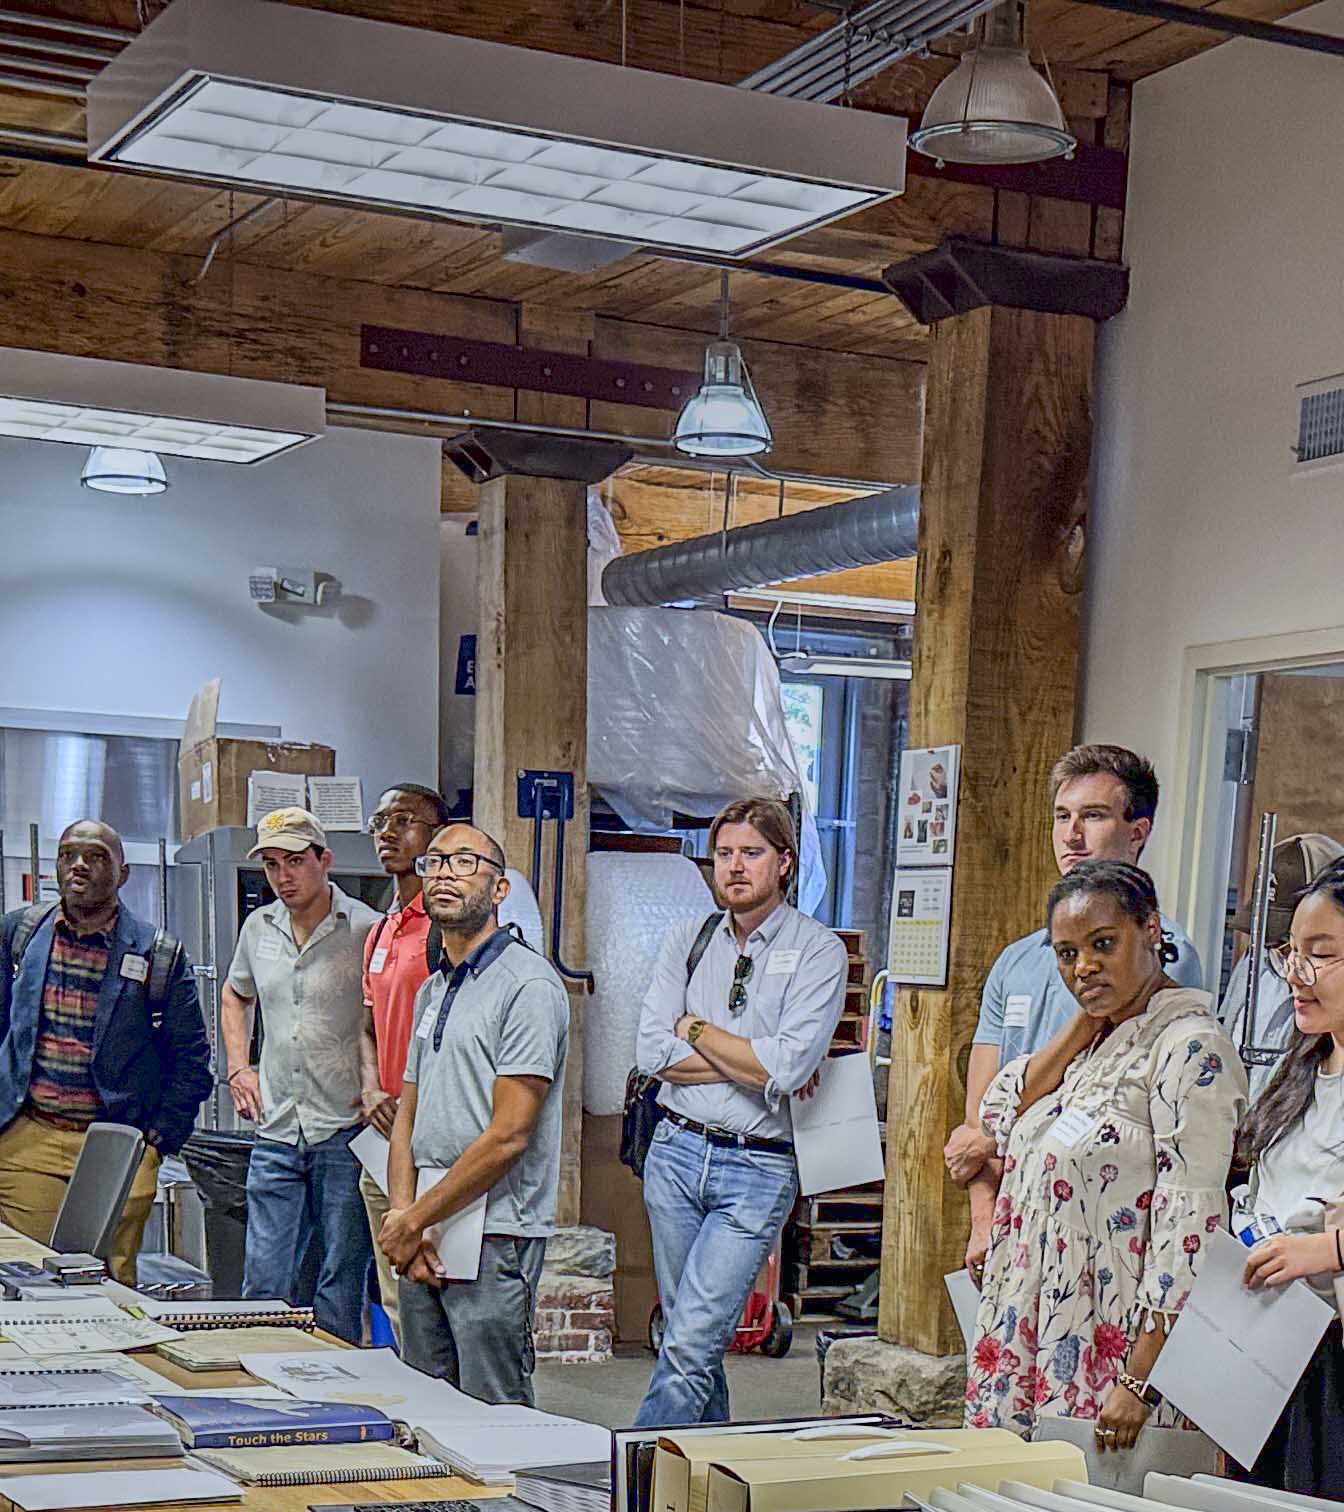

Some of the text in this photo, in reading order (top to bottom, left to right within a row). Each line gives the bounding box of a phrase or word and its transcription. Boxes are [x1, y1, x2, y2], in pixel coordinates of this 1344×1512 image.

[228, 1430, 328, 1446] Touch the Stars
